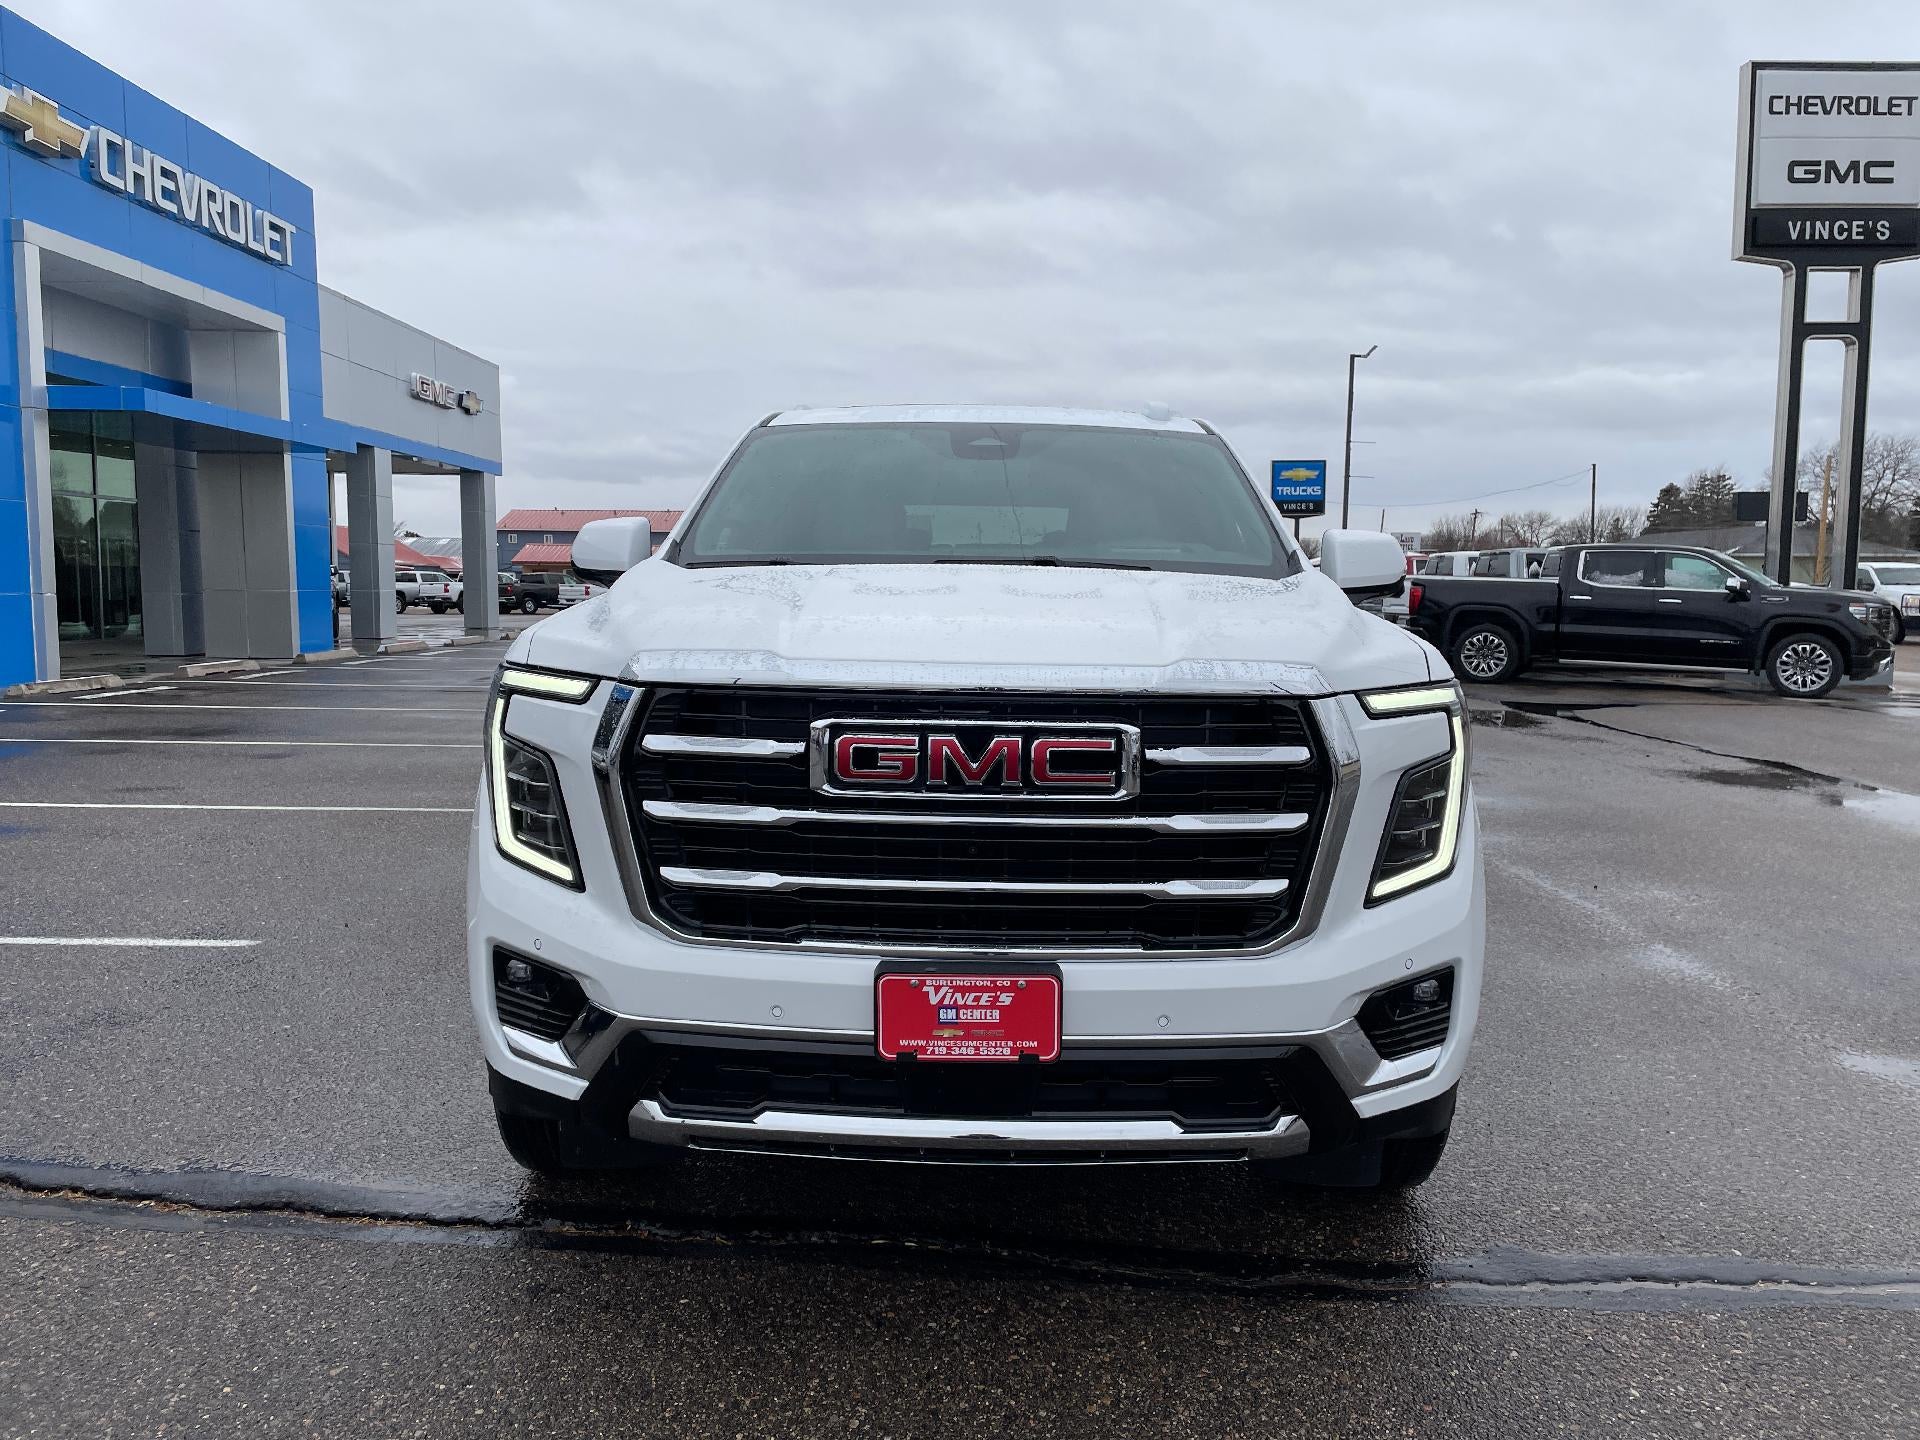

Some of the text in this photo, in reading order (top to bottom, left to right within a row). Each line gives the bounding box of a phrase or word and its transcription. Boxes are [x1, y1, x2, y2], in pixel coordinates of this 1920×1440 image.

[1768, 95, 1918, 116] CHEVROLET
[1787, 160, 1895, 184] GMC
[89, 125, 297, 267] CHEVROLET
[1788, 220, 1890, 240] VINCE'S
[411, 372, 456, 409] GMC
[1276, 486, 1322, 496] TRUCKS
[1283, 502, 1314, 510] VINCE'S
[834, 734, 1117, 787] GMC
[925, 979, 994, 987] BURLINGTON,
[939, 1008, 1000, 1020] GM CENTER
[899, 1039, 1038, 1048] WWW.VINCESGMCENTER.COM
